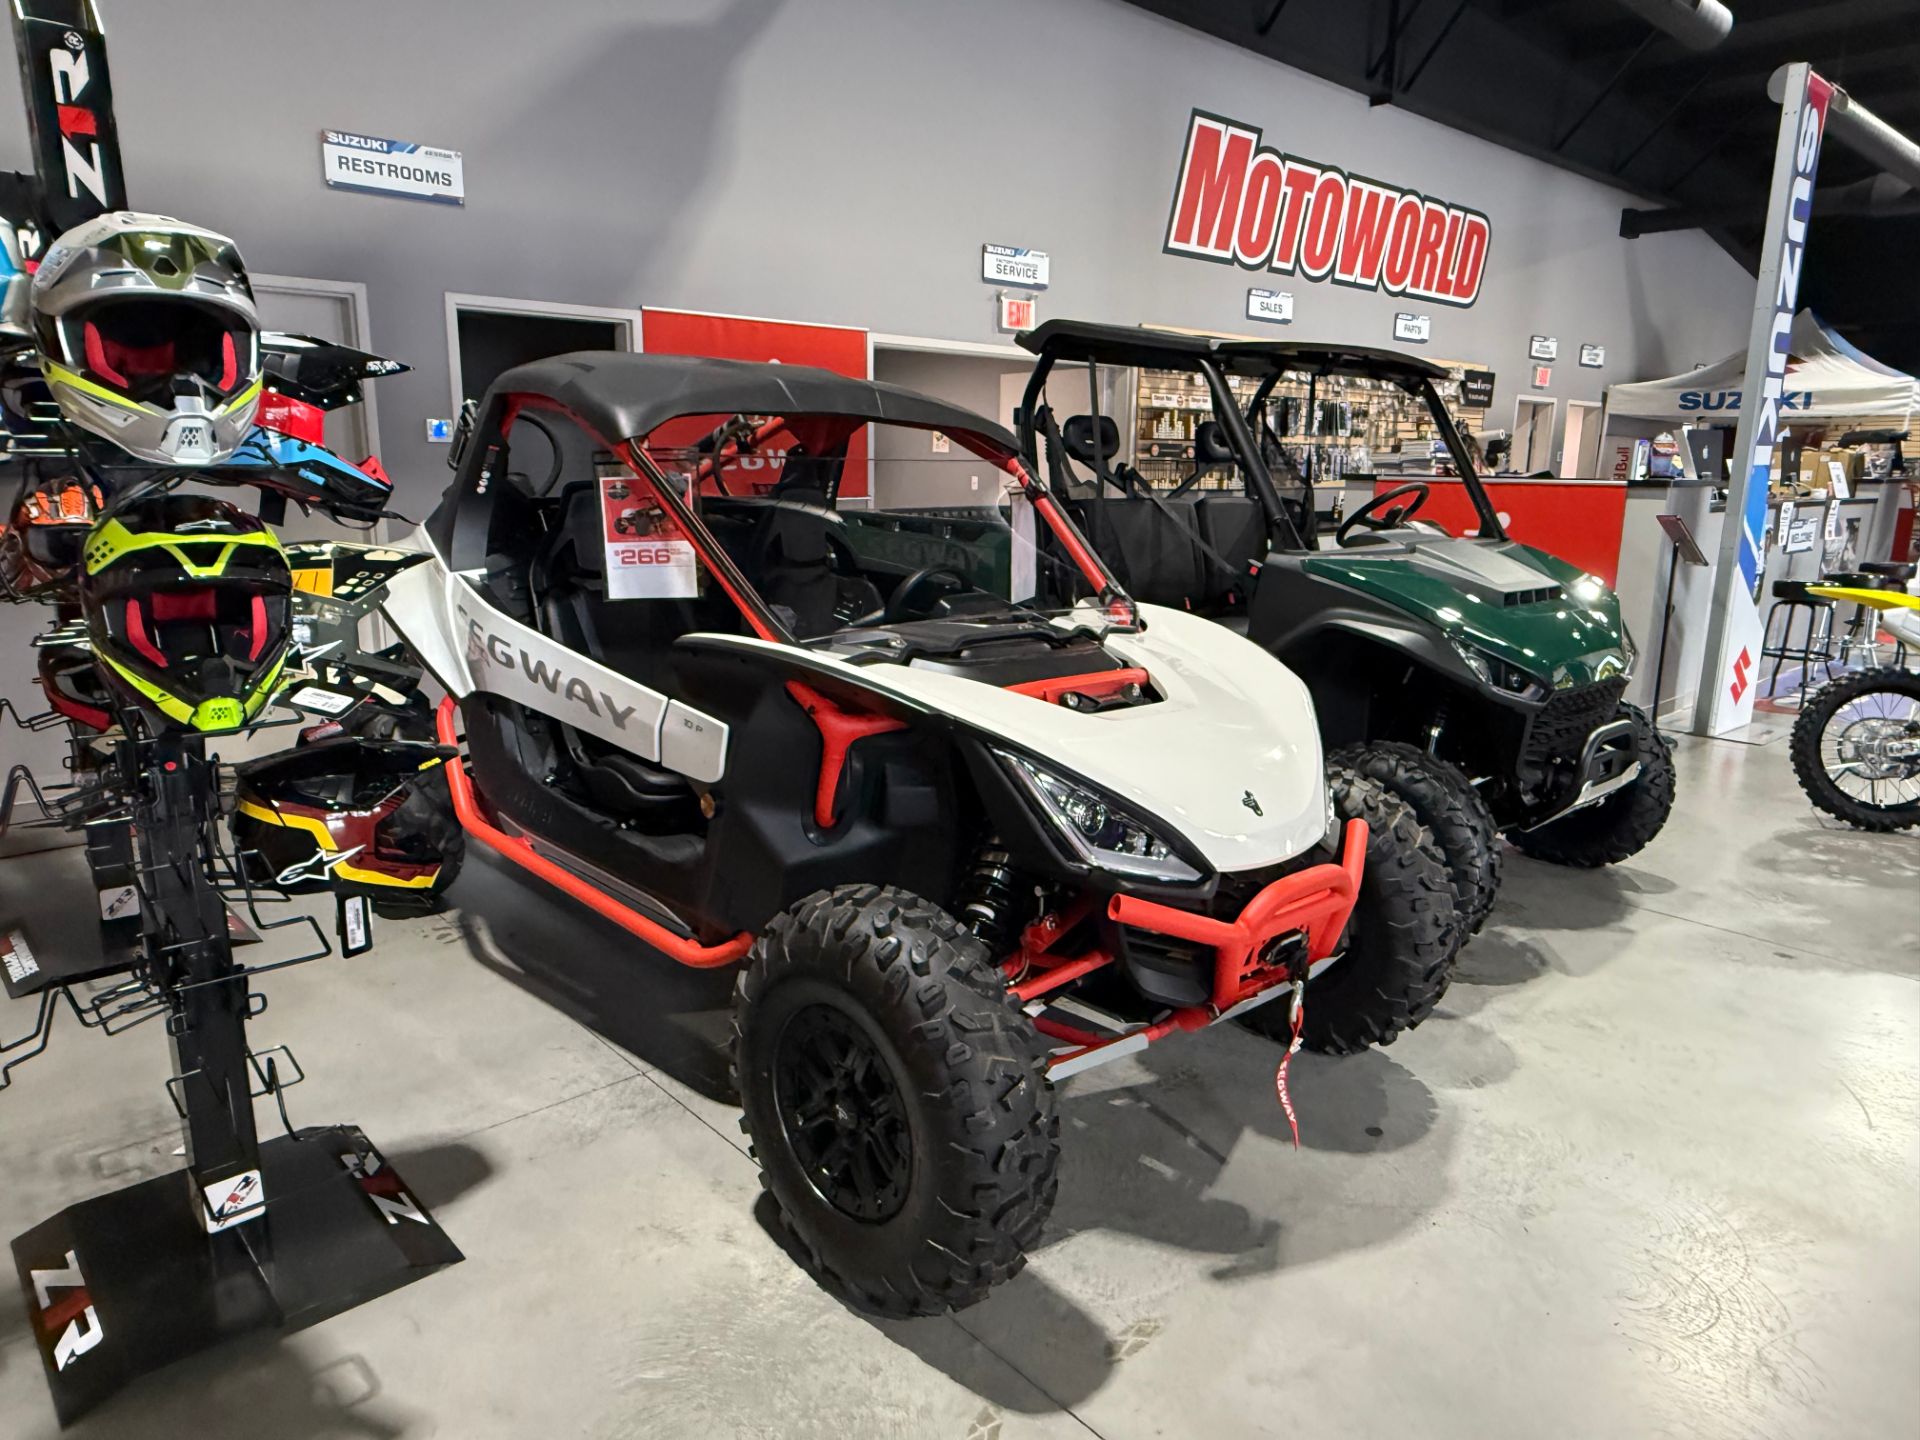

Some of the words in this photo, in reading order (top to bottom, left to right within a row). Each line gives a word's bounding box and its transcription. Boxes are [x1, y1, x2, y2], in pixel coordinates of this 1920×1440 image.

[327, 131, 388, 152] SUZUKI
[337, 155, 453, 187] RESTROOMS
[1170, 120, 1491, 302] MOTOWORLD
[996, 263, 1038, 280] SERVICE
[1753, 102, 1820, 466] SUZUKI
[1008, 301, 1031, 328] EXIT
[1259, 301, 1283, 314] SALES
[1403, 323, 1422, 335] PARTS
[1678, 391, 1813, 411] SUZKI
[457, 604, 637, 731] EGWAY
